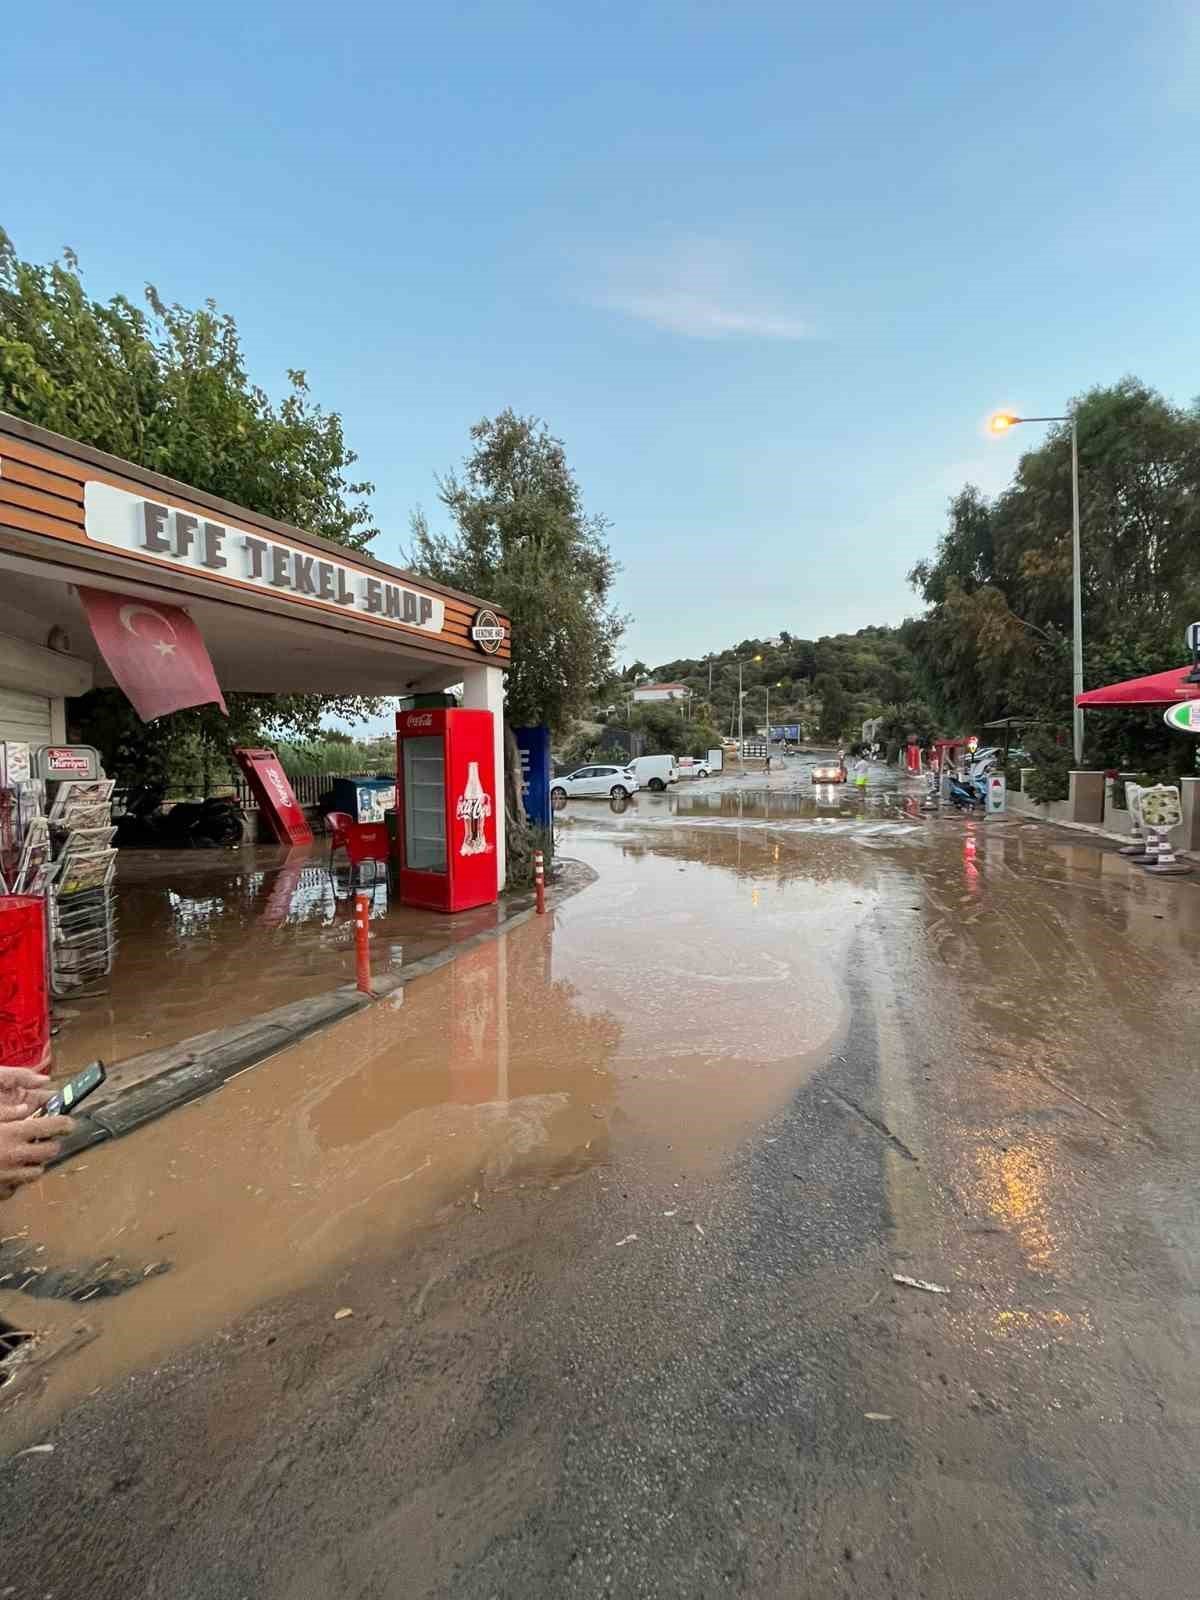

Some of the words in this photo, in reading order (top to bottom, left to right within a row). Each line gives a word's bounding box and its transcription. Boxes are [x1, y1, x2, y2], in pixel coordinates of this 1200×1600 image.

[141, 501, 228, 569] EFE
[243, 535, 354, 605] TEKEL
[365, 577, 433, 626] SHOP
